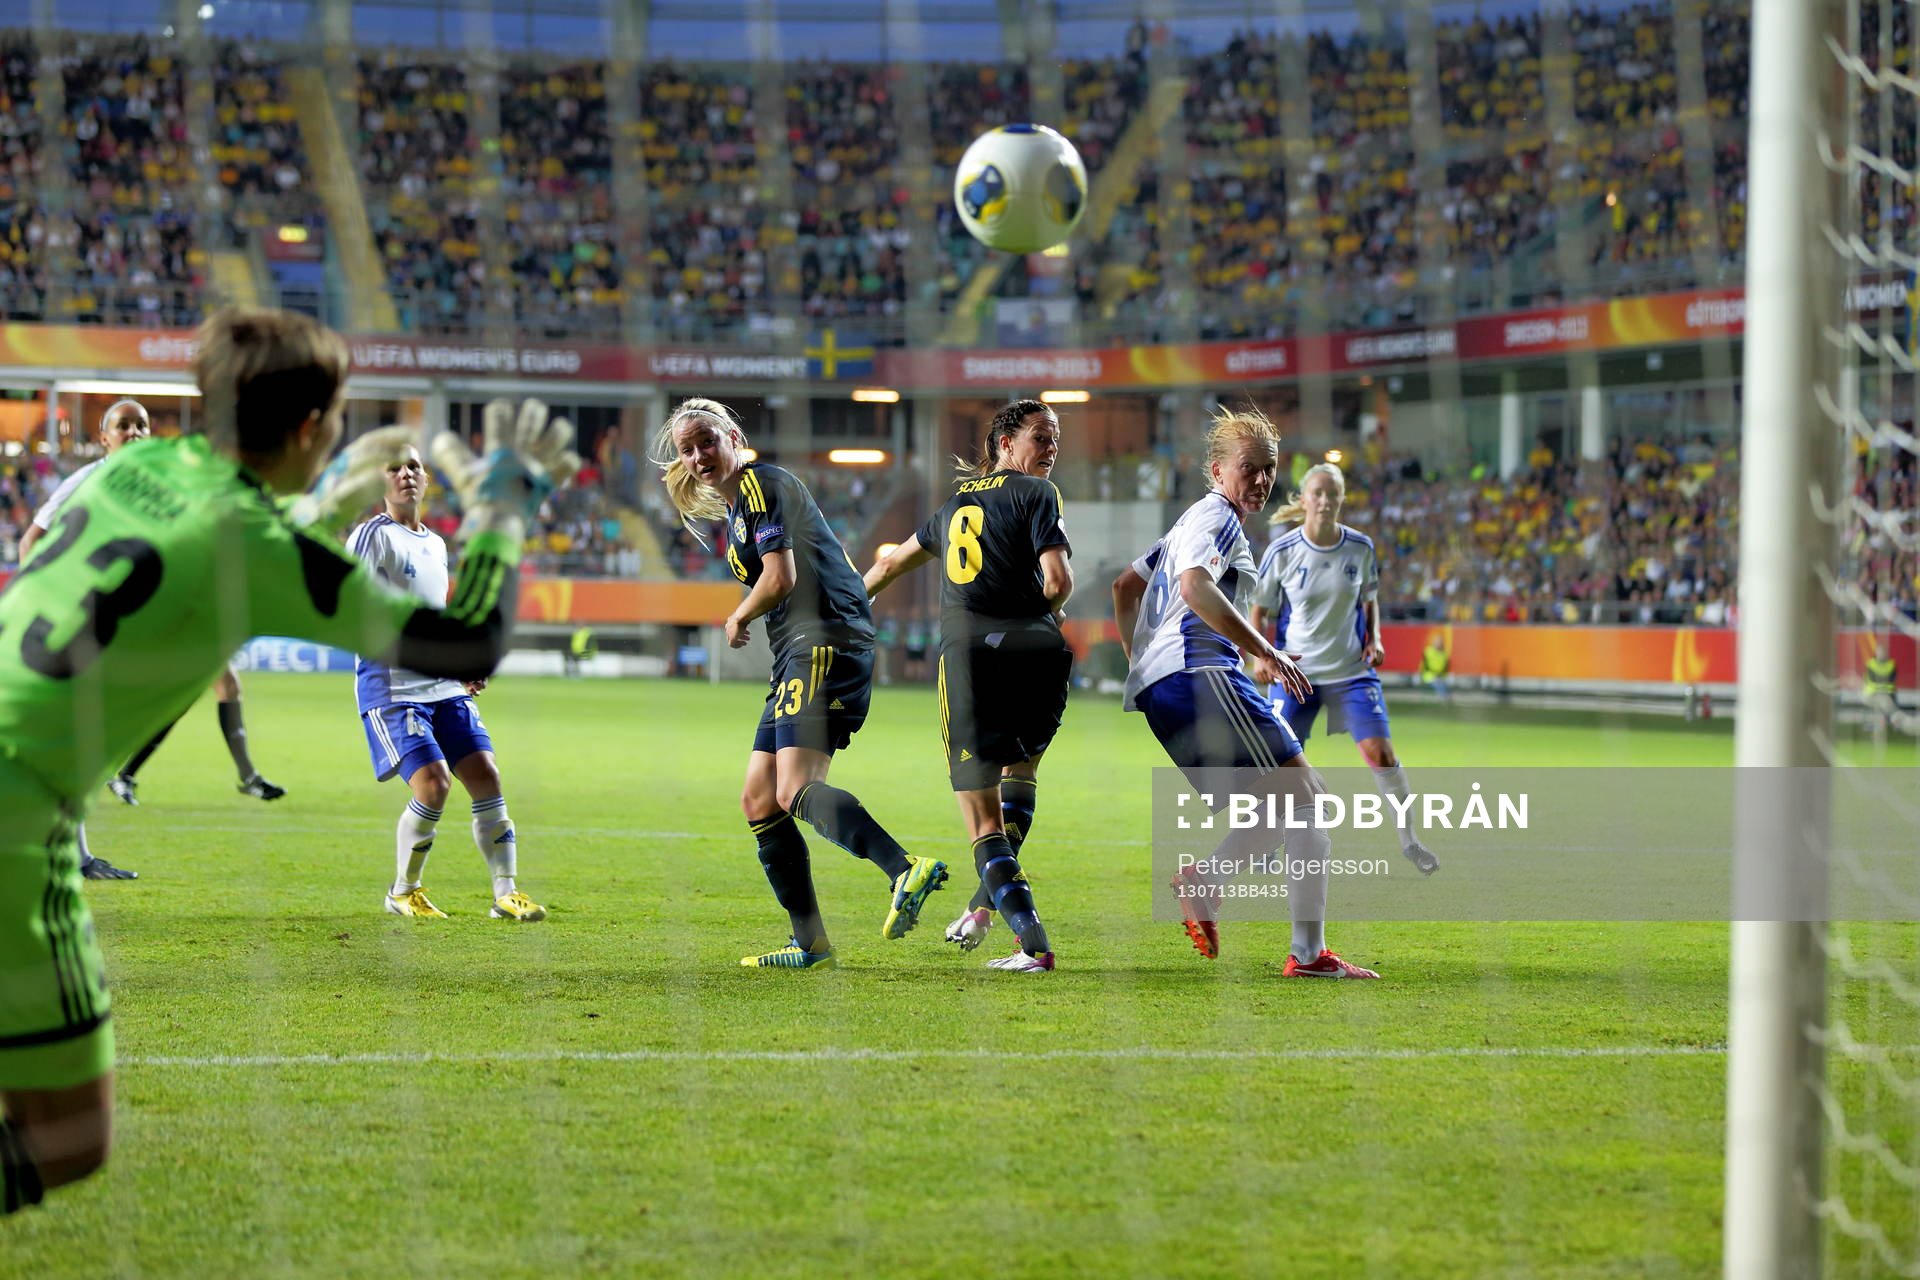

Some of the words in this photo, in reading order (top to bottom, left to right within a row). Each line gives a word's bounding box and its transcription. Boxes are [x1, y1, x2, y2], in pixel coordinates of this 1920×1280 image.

[353, 345, 415, 368] UEFA
[416, 346, 517, 371] WOMEN'S
[519, 350, 582, 373] EURO
[651, 352, 710, 376] UEFA
[955, 475, 1009, 496] SCHELIN
[760, 526, 784, 537] RESPECT
[946, 505, 985, 584] 8
[404, 558, 417, 579] 4
[1297, 567, 1308, 590] 7
[774, 678, 804, 719] 23
